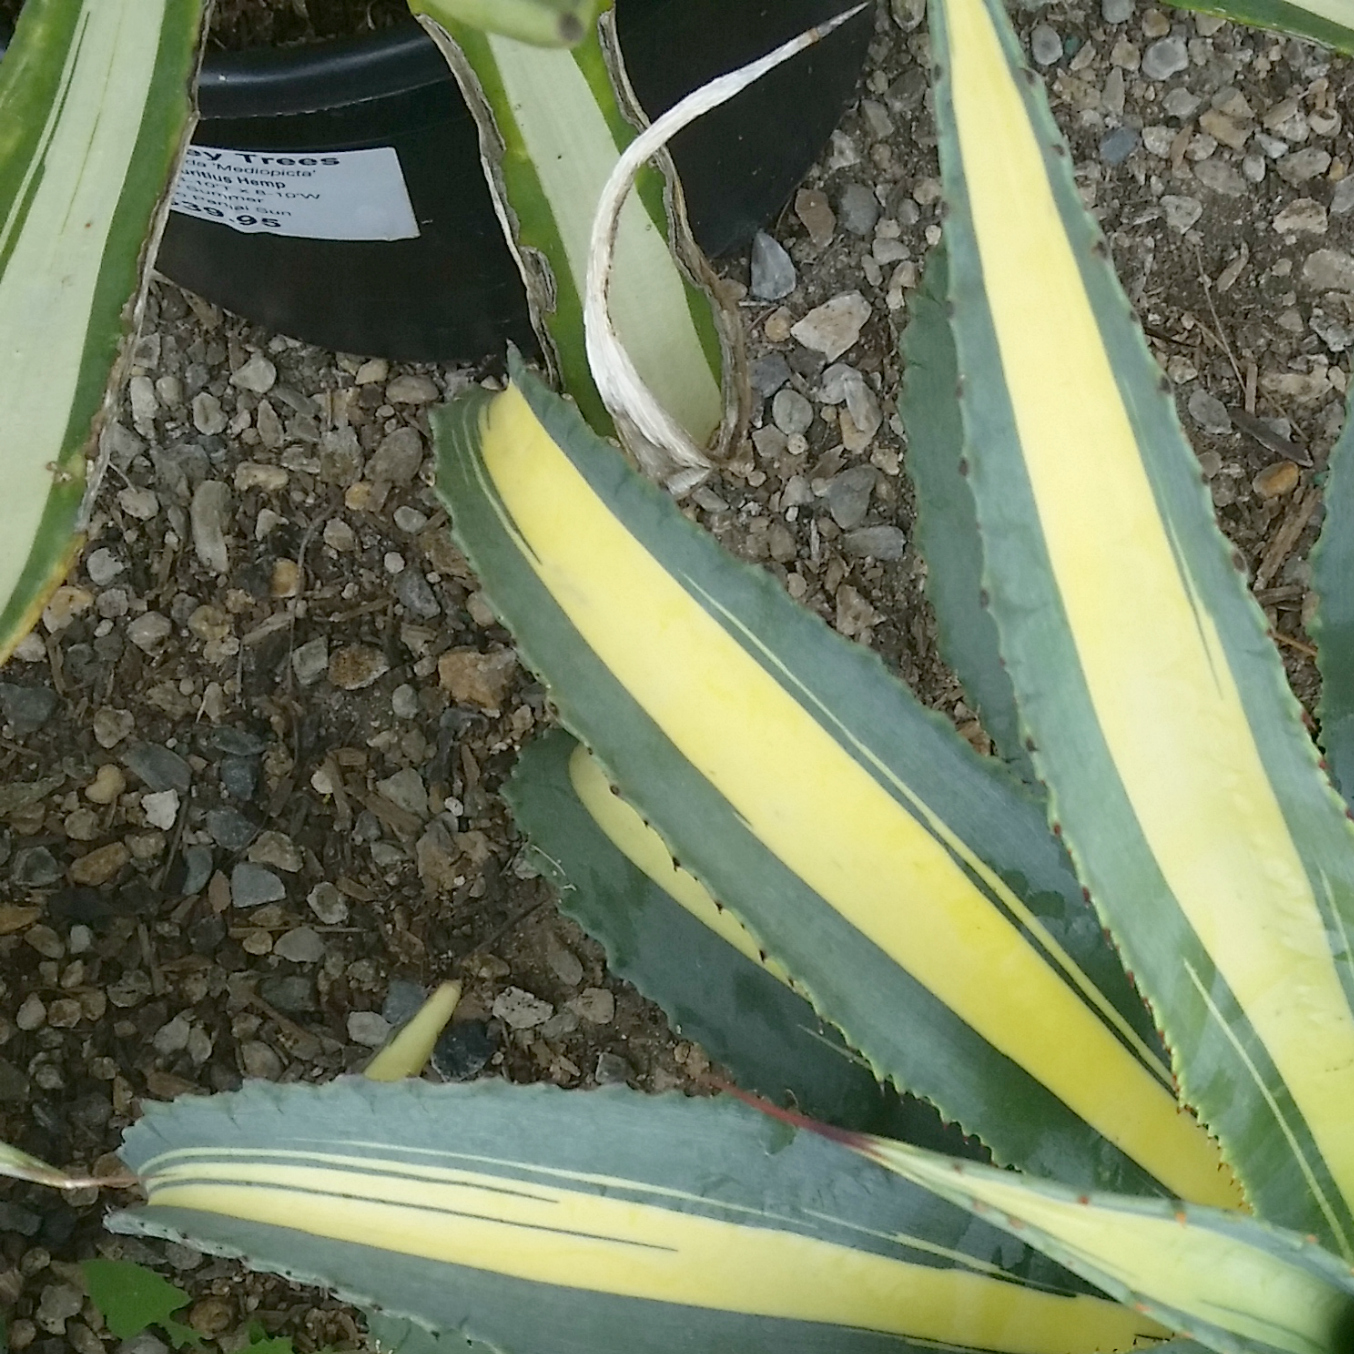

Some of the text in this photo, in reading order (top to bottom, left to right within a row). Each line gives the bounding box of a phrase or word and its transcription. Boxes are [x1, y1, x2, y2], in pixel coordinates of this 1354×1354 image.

[235, 153, 340, 166] Trees
[237, 177, 286, 190] Hemp
[186, 185, 264, 204] Summer
[256, 205, 292, 217] Sun
